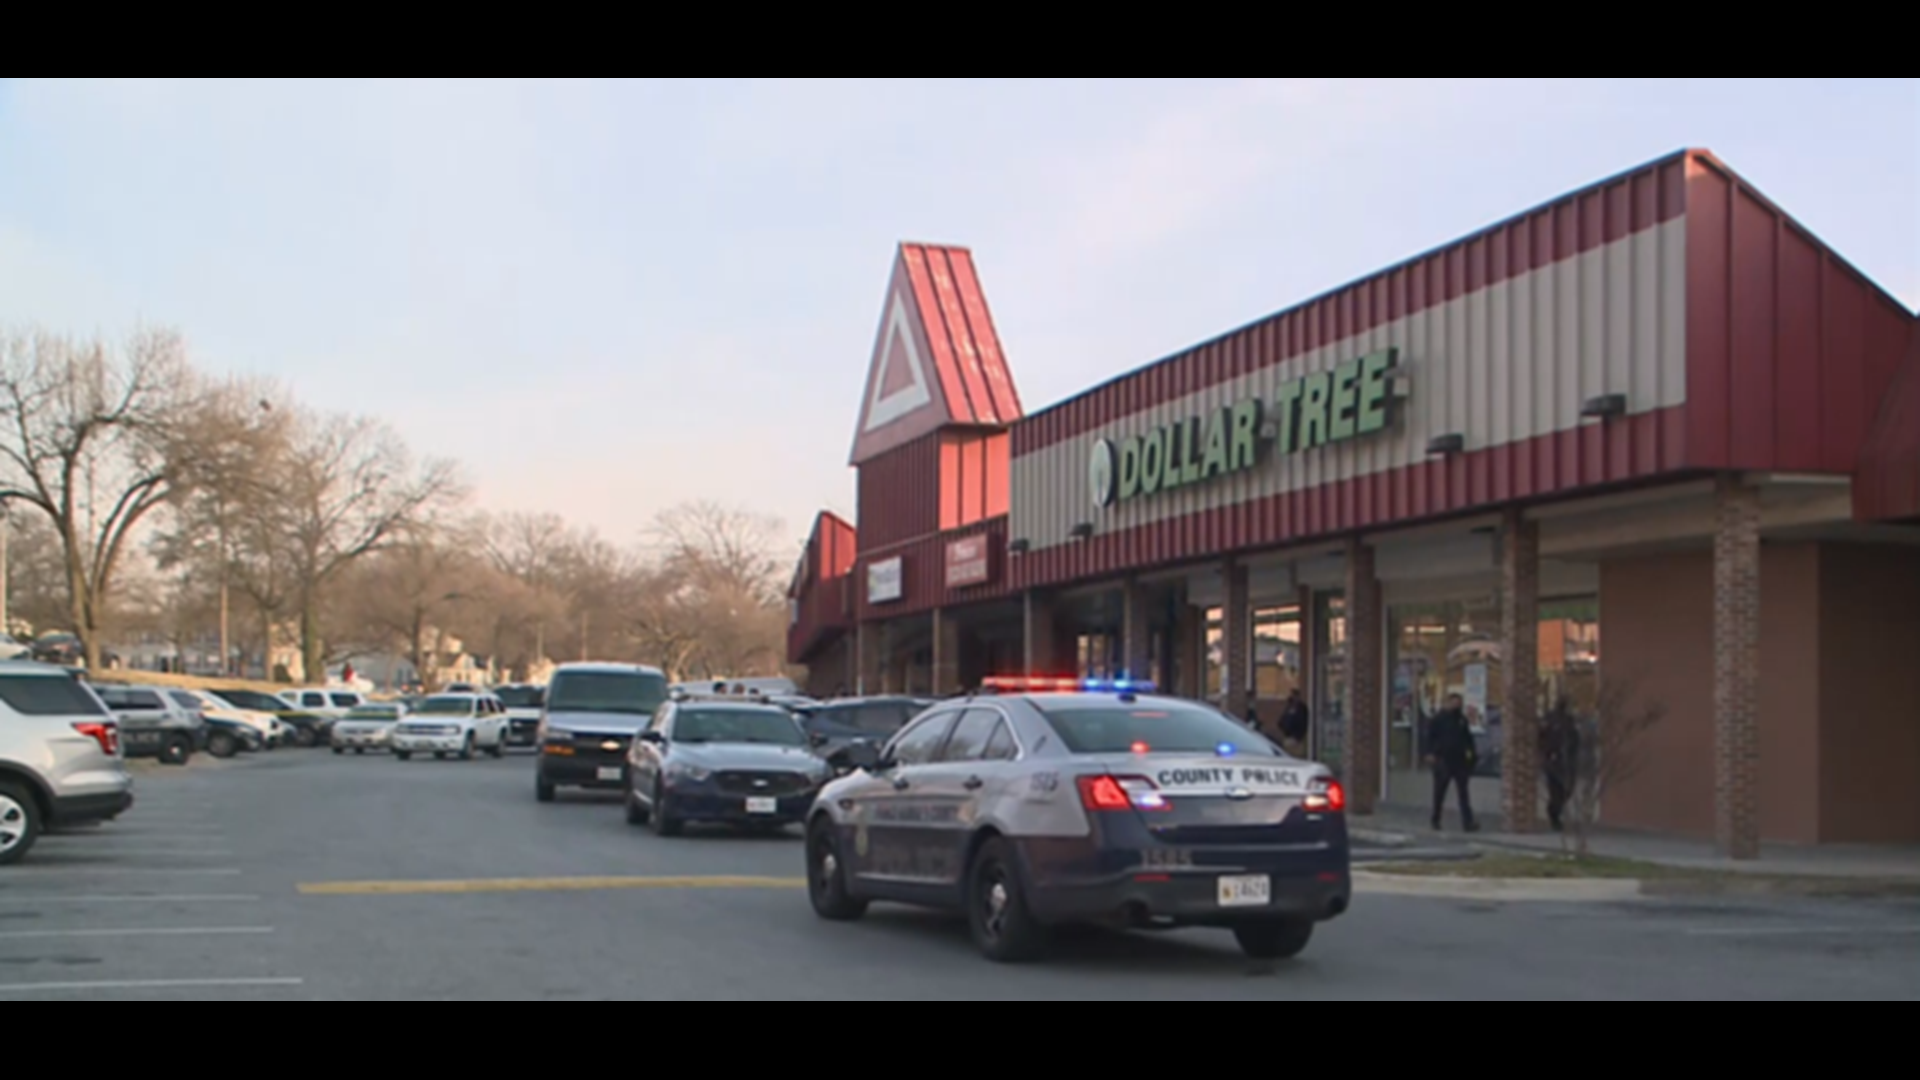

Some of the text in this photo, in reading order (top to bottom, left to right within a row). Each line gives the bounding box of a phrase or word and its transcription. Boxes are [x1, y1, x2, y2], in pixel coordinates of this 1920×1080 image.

[1119, 347, 1395, 499] DOLLAR TREE
[1158, 768, 1300, 786] COUNTY POLICE
